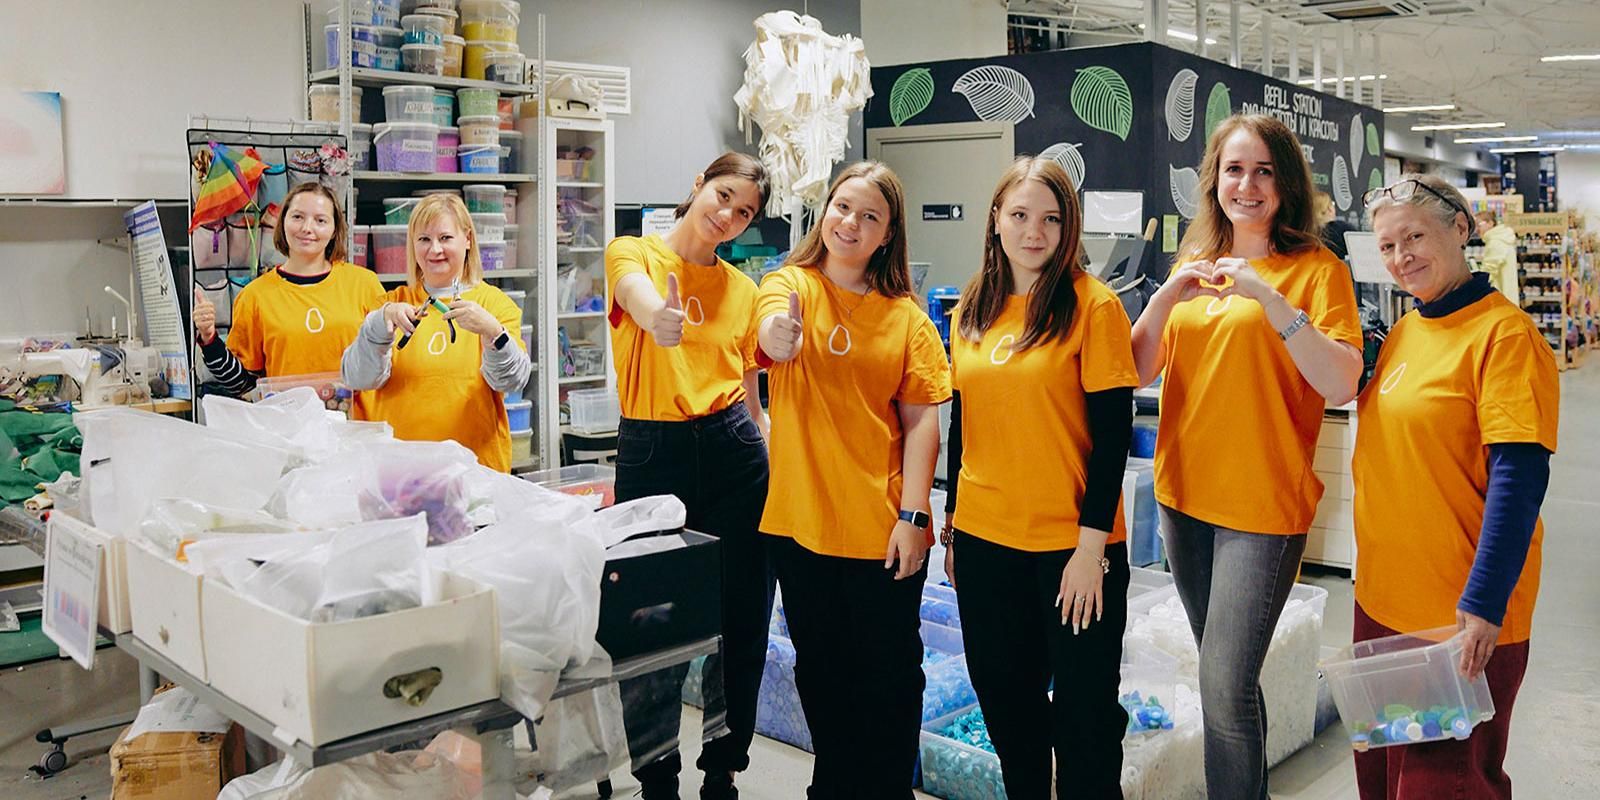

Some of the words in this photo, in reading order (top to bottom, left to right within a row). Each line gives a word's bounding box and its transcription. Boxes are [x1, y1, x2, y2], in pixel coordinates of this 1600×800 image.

[1264, 84, 1290, 109] REFILL
[1292, 92, 1322, 119] STATION
[1300, 115, 1307, 136] И
[1308, 117, 1339, 142] КРАСОТЫ
